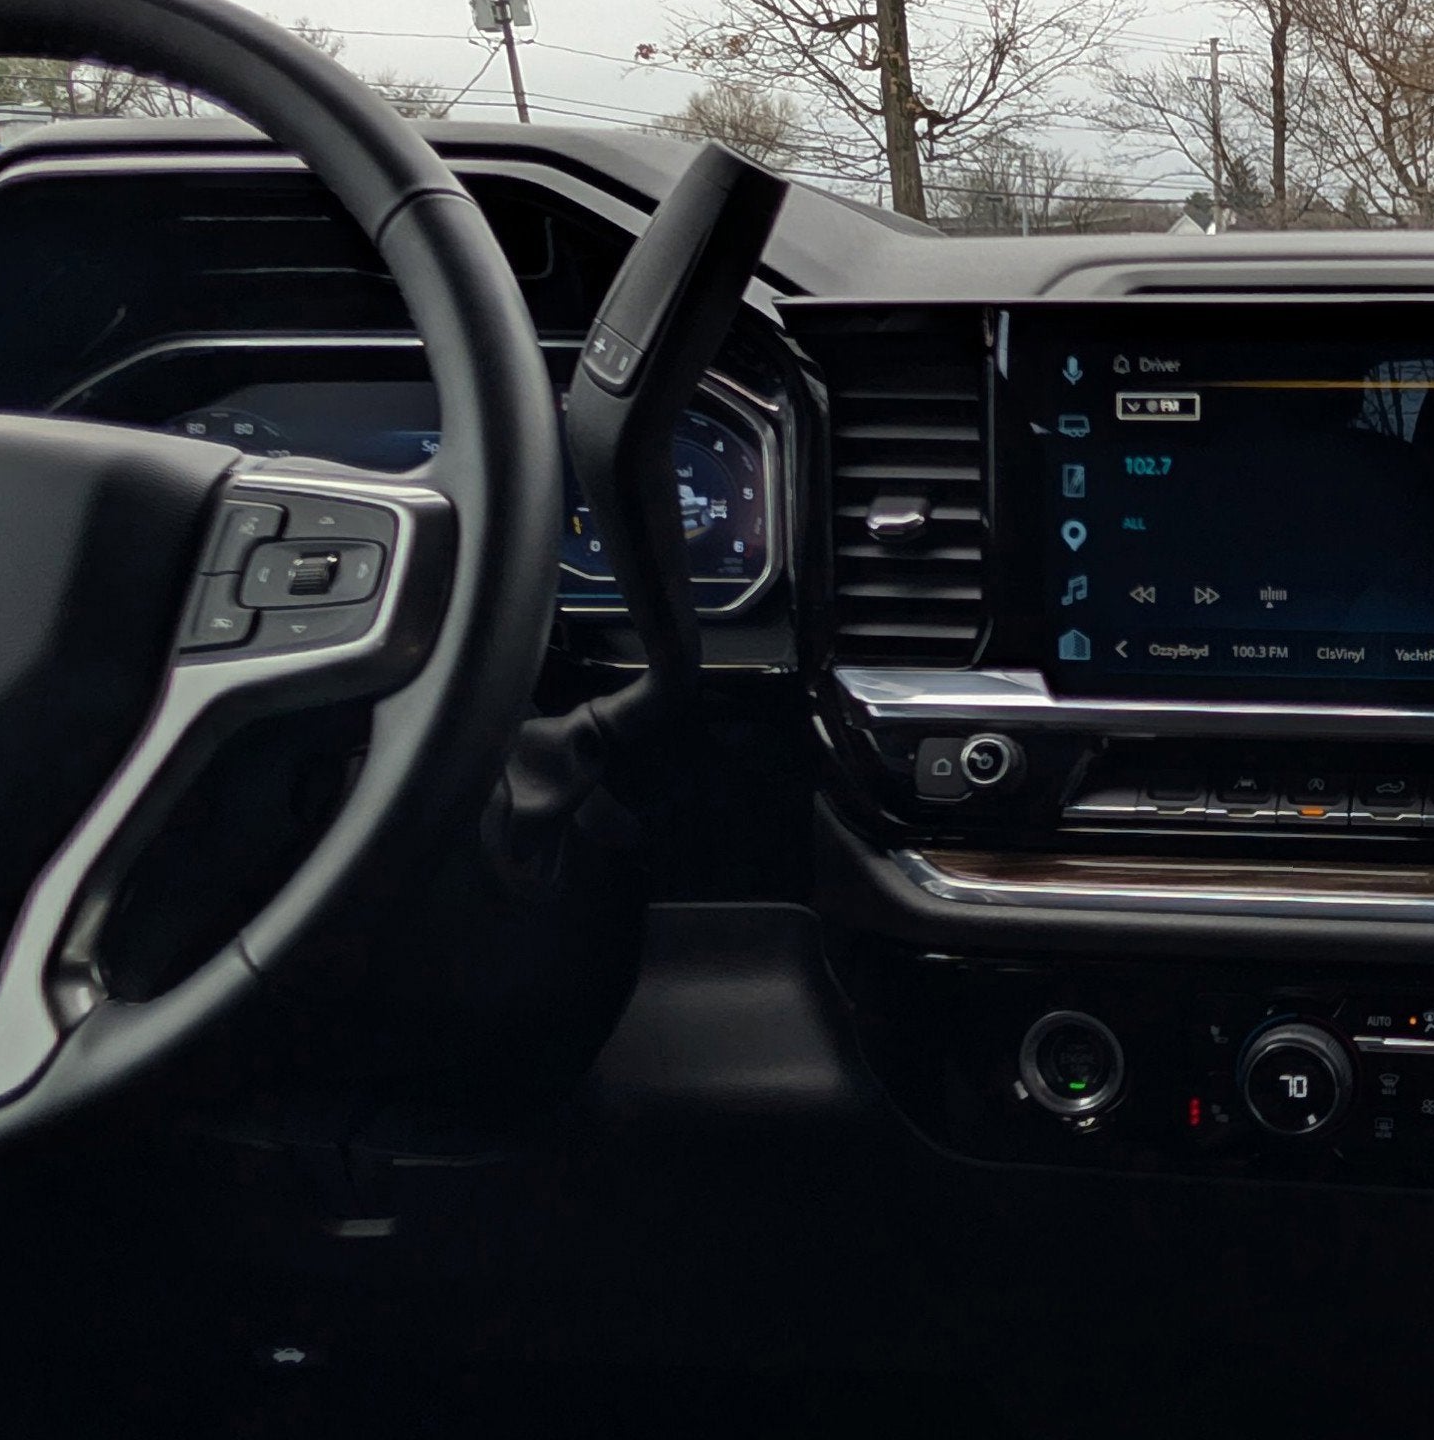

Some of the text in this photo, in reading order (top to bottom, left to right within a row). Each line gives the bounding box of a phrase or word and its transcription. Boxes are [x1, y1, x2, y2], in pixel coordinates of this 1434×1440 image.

[1139, 357, 1182, 373] Driver
[1124, 456, 1173, 475] 102.7
[1121, 517, 1147, 530] ALL
[1231, 645, 1289, 659] 100.3 FM
[1366, 1015, 1392, 1027] AUTO
[1278, 1073, 1308, 1098] 70
